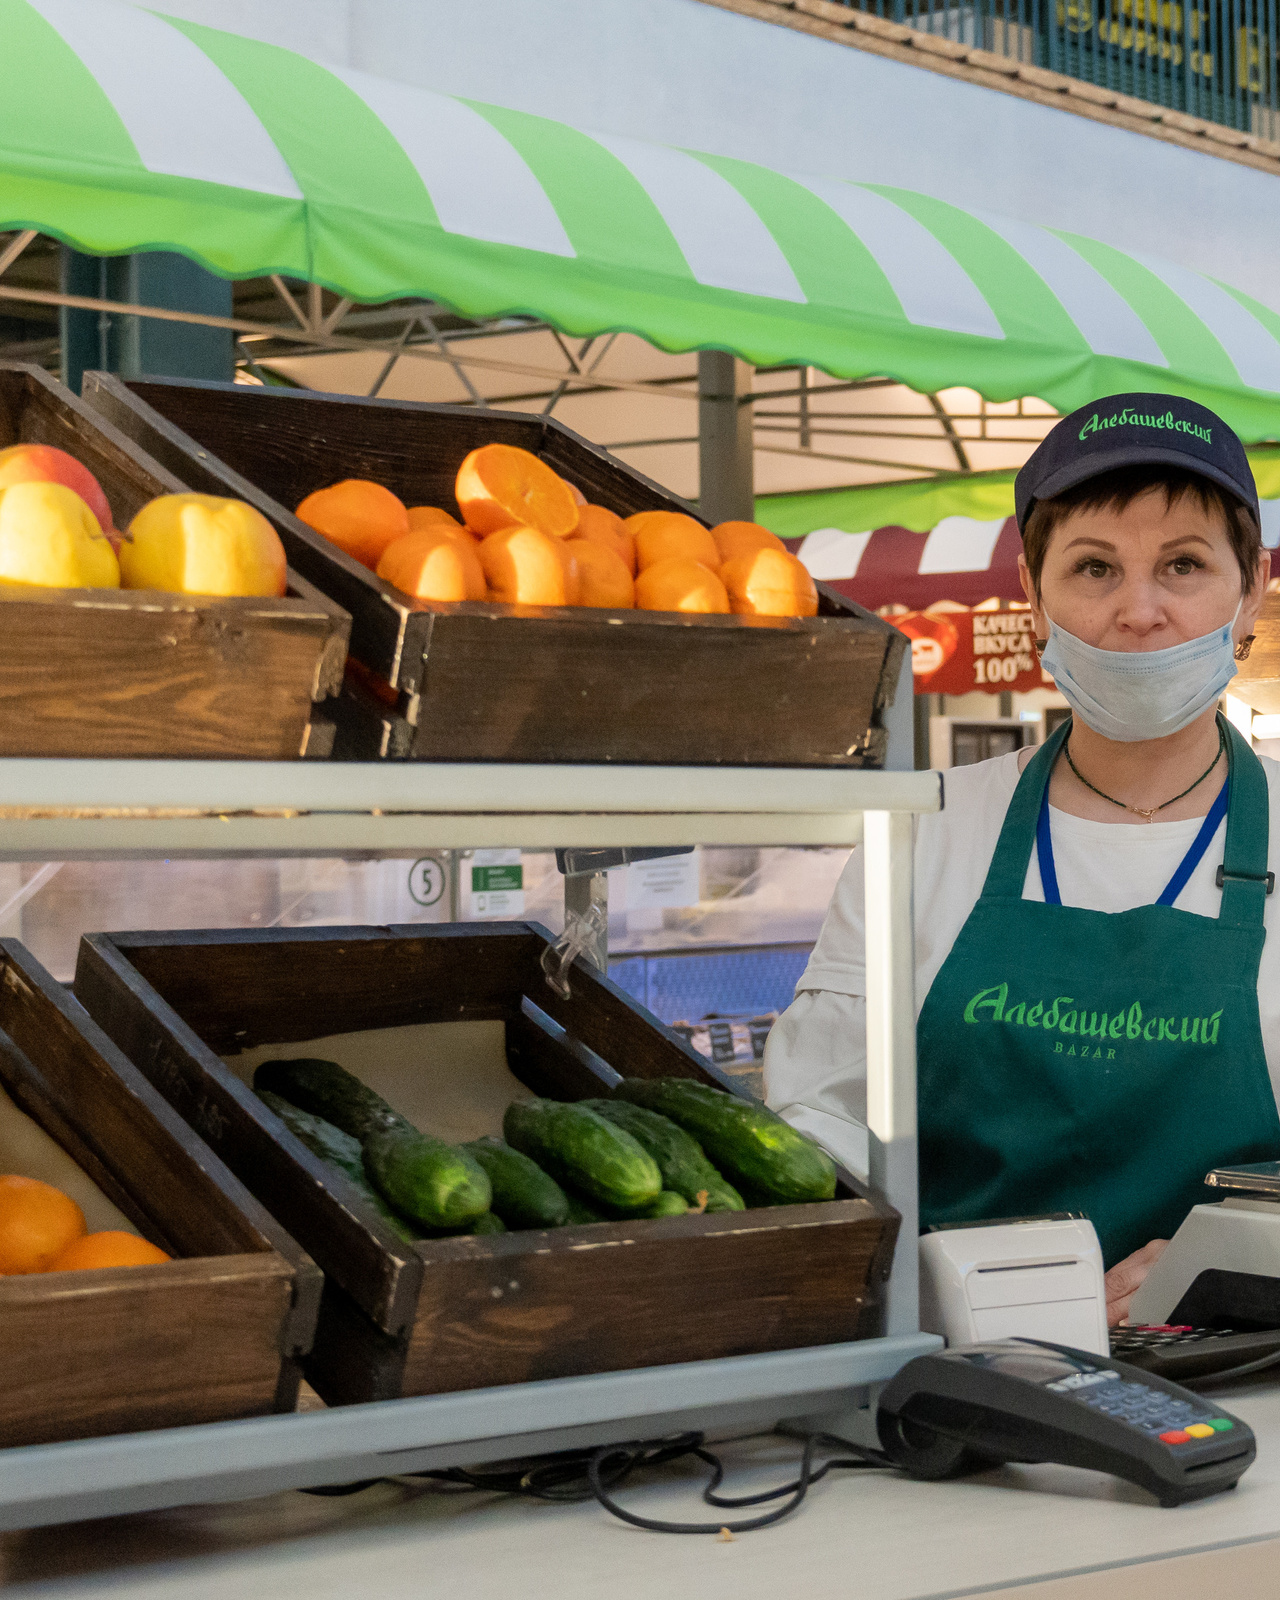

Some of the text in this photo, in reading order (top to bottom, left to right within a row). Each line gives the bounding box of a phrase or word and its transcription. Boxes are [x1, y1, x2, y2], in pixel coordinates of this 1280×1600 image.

[1078, 408, 1212, 444] Алебашевский
[973, 634, 1032, 655] ВКУСА
[973, 653, 1034, 684] 100%
[421, 868, 433, 896] 5
[963, 982, 1224, 1045] Алебашевский
[1053, 1041, 1117, 1060] BAZAR
